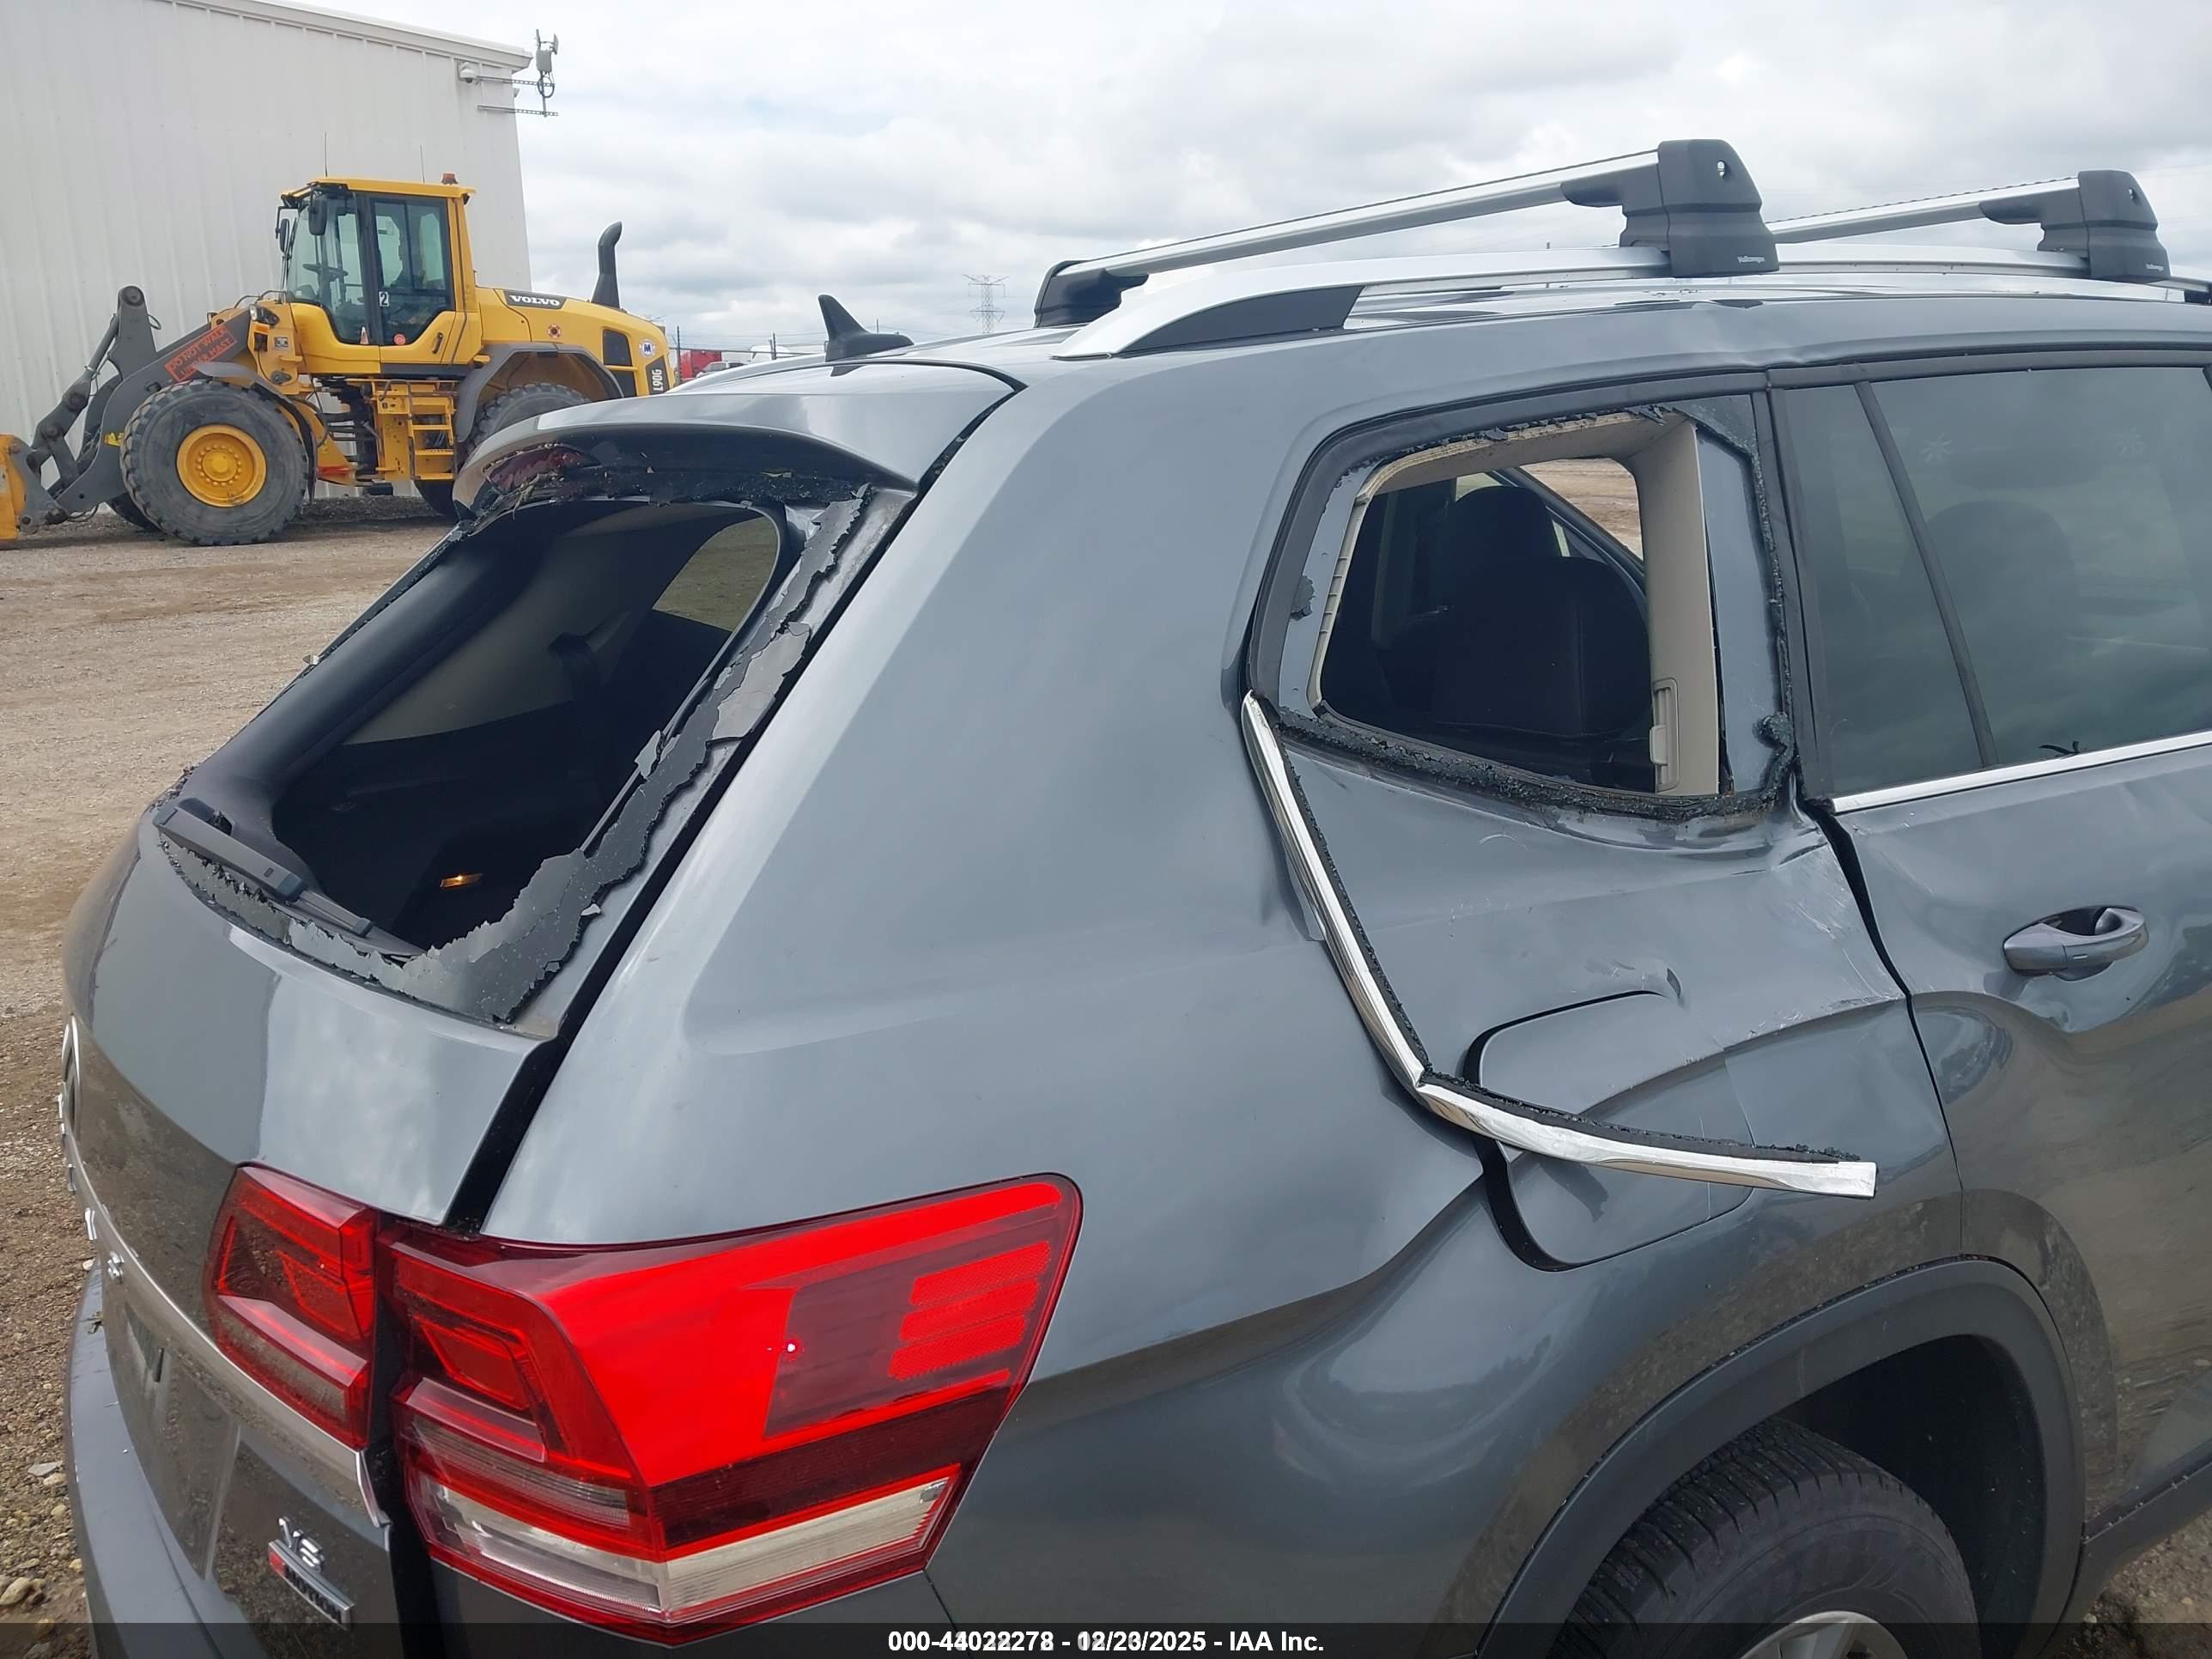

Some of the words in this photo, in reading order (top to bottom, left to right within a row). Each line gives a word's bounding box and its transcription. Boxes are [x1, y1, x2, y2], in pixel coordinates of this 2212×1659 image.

[380, 294, 388, 305] 2
[509, 295, 560, 307] VOLVO
[652, 369, 664, 392] L90G
